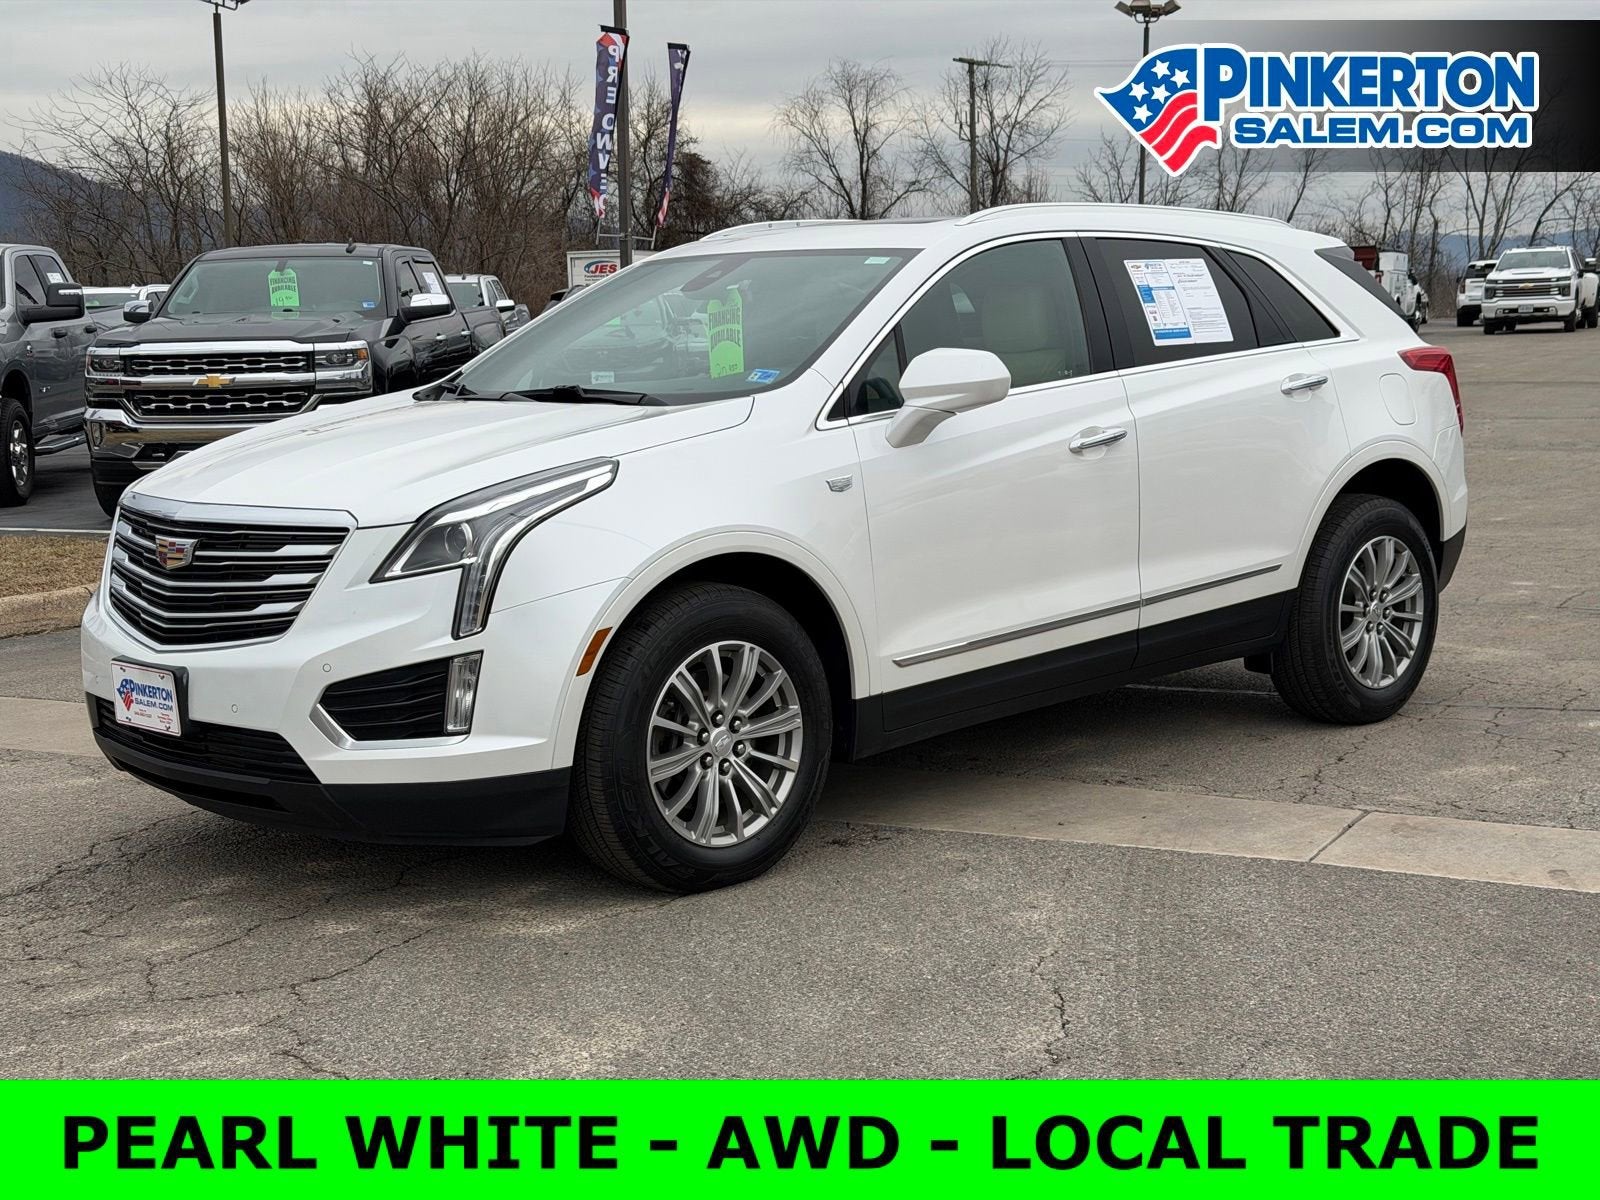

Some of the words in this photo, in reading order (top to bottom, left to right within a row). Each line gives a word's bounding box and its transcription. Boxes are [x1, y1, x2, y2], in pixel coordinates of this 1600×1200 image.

[590, 264, 617, 274] JES
[270, 275, 296, 286] FINANCING
[271, 284, 297, 295] AVAILABLE
[708, 307, 741, 332] FINANCING
[710, 327, 742, 353] AVAILABLE
[128, 678, 174, 703] PINKERTON
[134, 697, 174, 713] SALEM.COM
